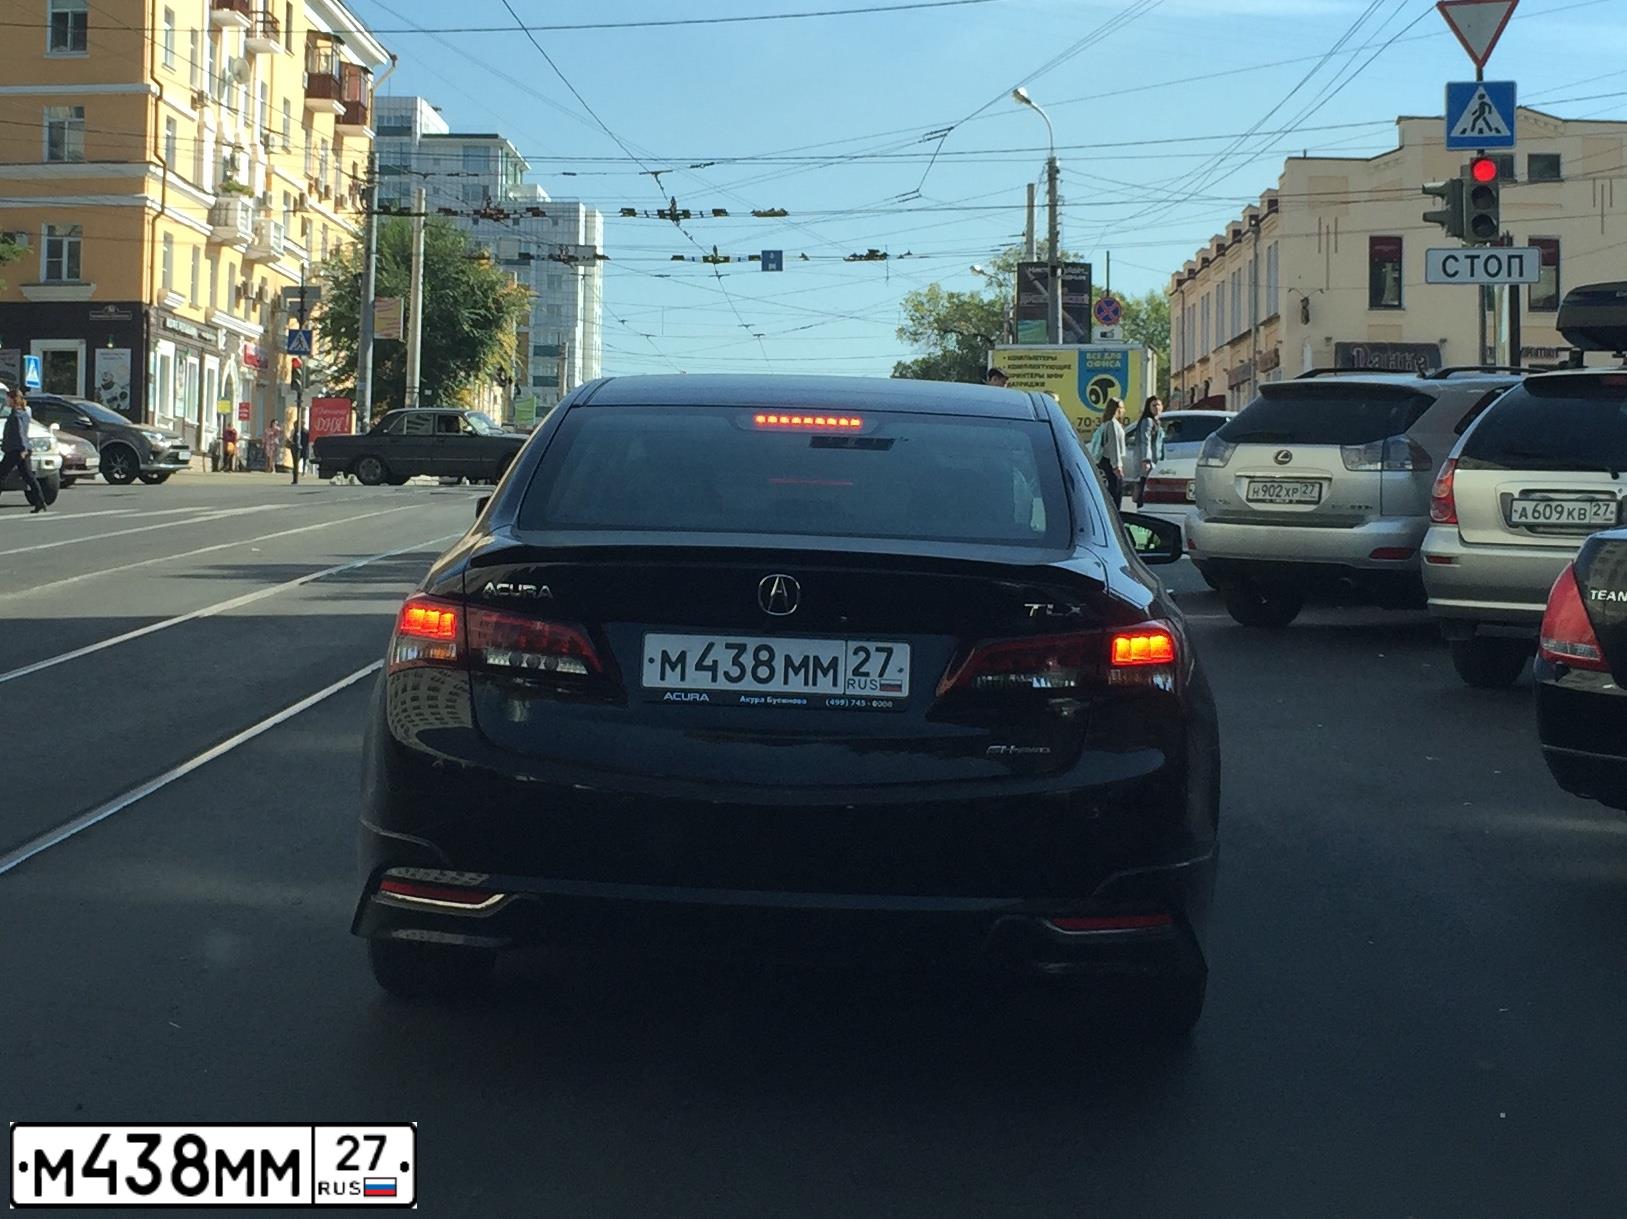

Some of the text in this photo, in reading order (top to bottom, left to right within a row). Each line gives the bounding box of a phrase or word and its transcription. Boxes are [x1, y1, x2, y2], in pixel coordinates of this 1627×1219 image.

[1442, 254, 1523, 278] СТОП
[1252, 484, 1315, 498] Н902ХР 27
[1518, 503, 1610, 521] А609КВ 27
[483, 582, 554, 599] ACURA
[1024, 603, 1086, 617] TLX
[659, 641, 894, 687] М438ММ 27
[846, 678, 878, 691] RUS
[663, 692, 710, 702] ACURA
[739, 695, 765, 705] Акура
[825, 698, 849, 707] (499)
